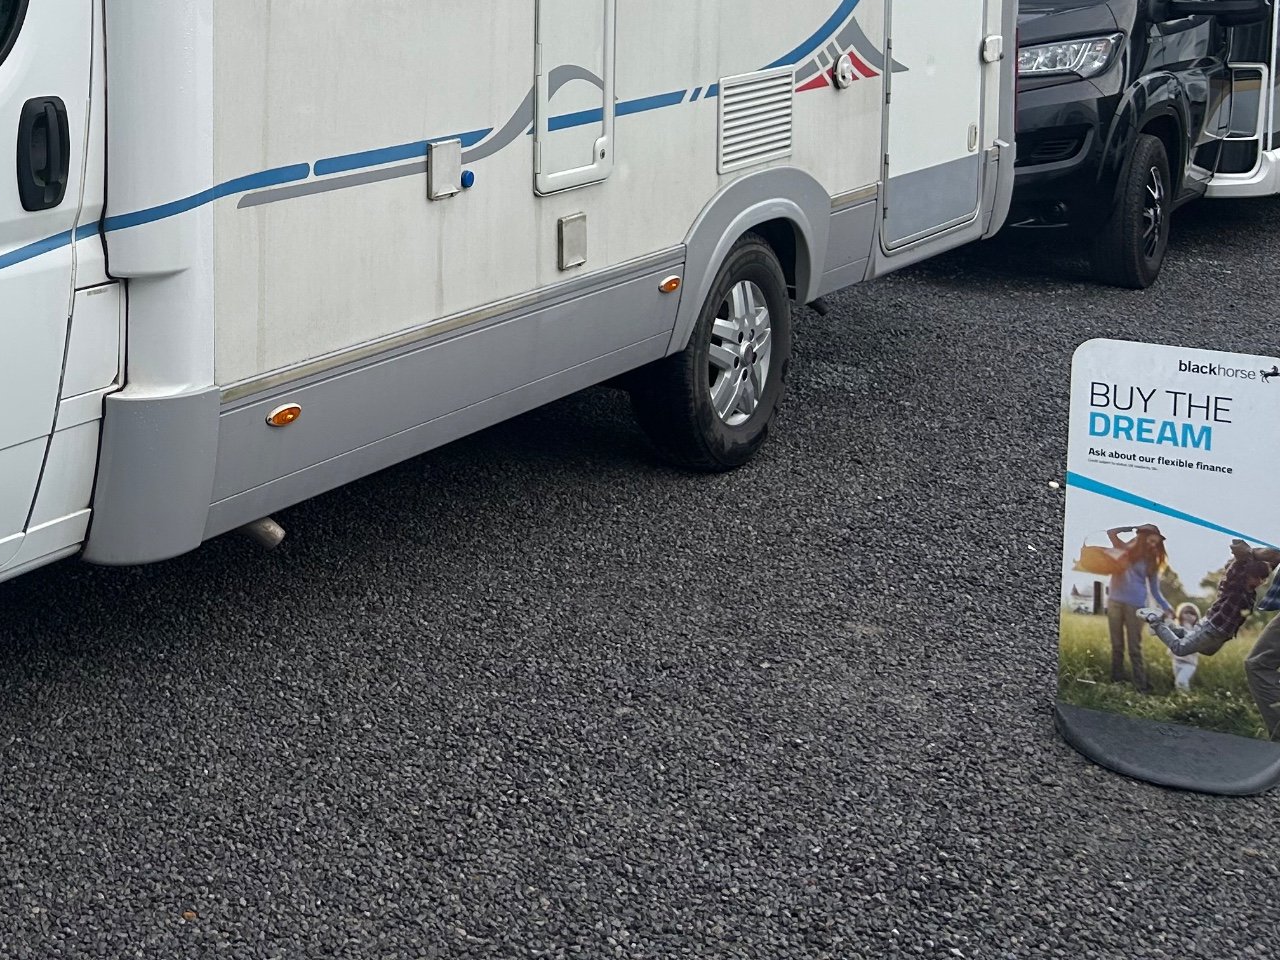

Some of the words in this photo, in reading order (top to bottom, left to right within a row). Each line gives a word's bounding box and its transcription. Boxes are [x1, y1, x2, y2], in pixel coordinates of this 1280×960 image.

[1178, 359, 1256, 380] blackhorse
[1090, 382, 1157, 413] BUY
[1165, 390, 1233, 424] THE
[1088, 411, 1212, 451] DREAM
[1088, 447, 1106, 457] Ask
[1108, 450, 1136, 461] about
[1138, 455, 1155, 464] our
[1157, 456, 1194, 470] flexible
[1195, 462, 1233, 474] finance
